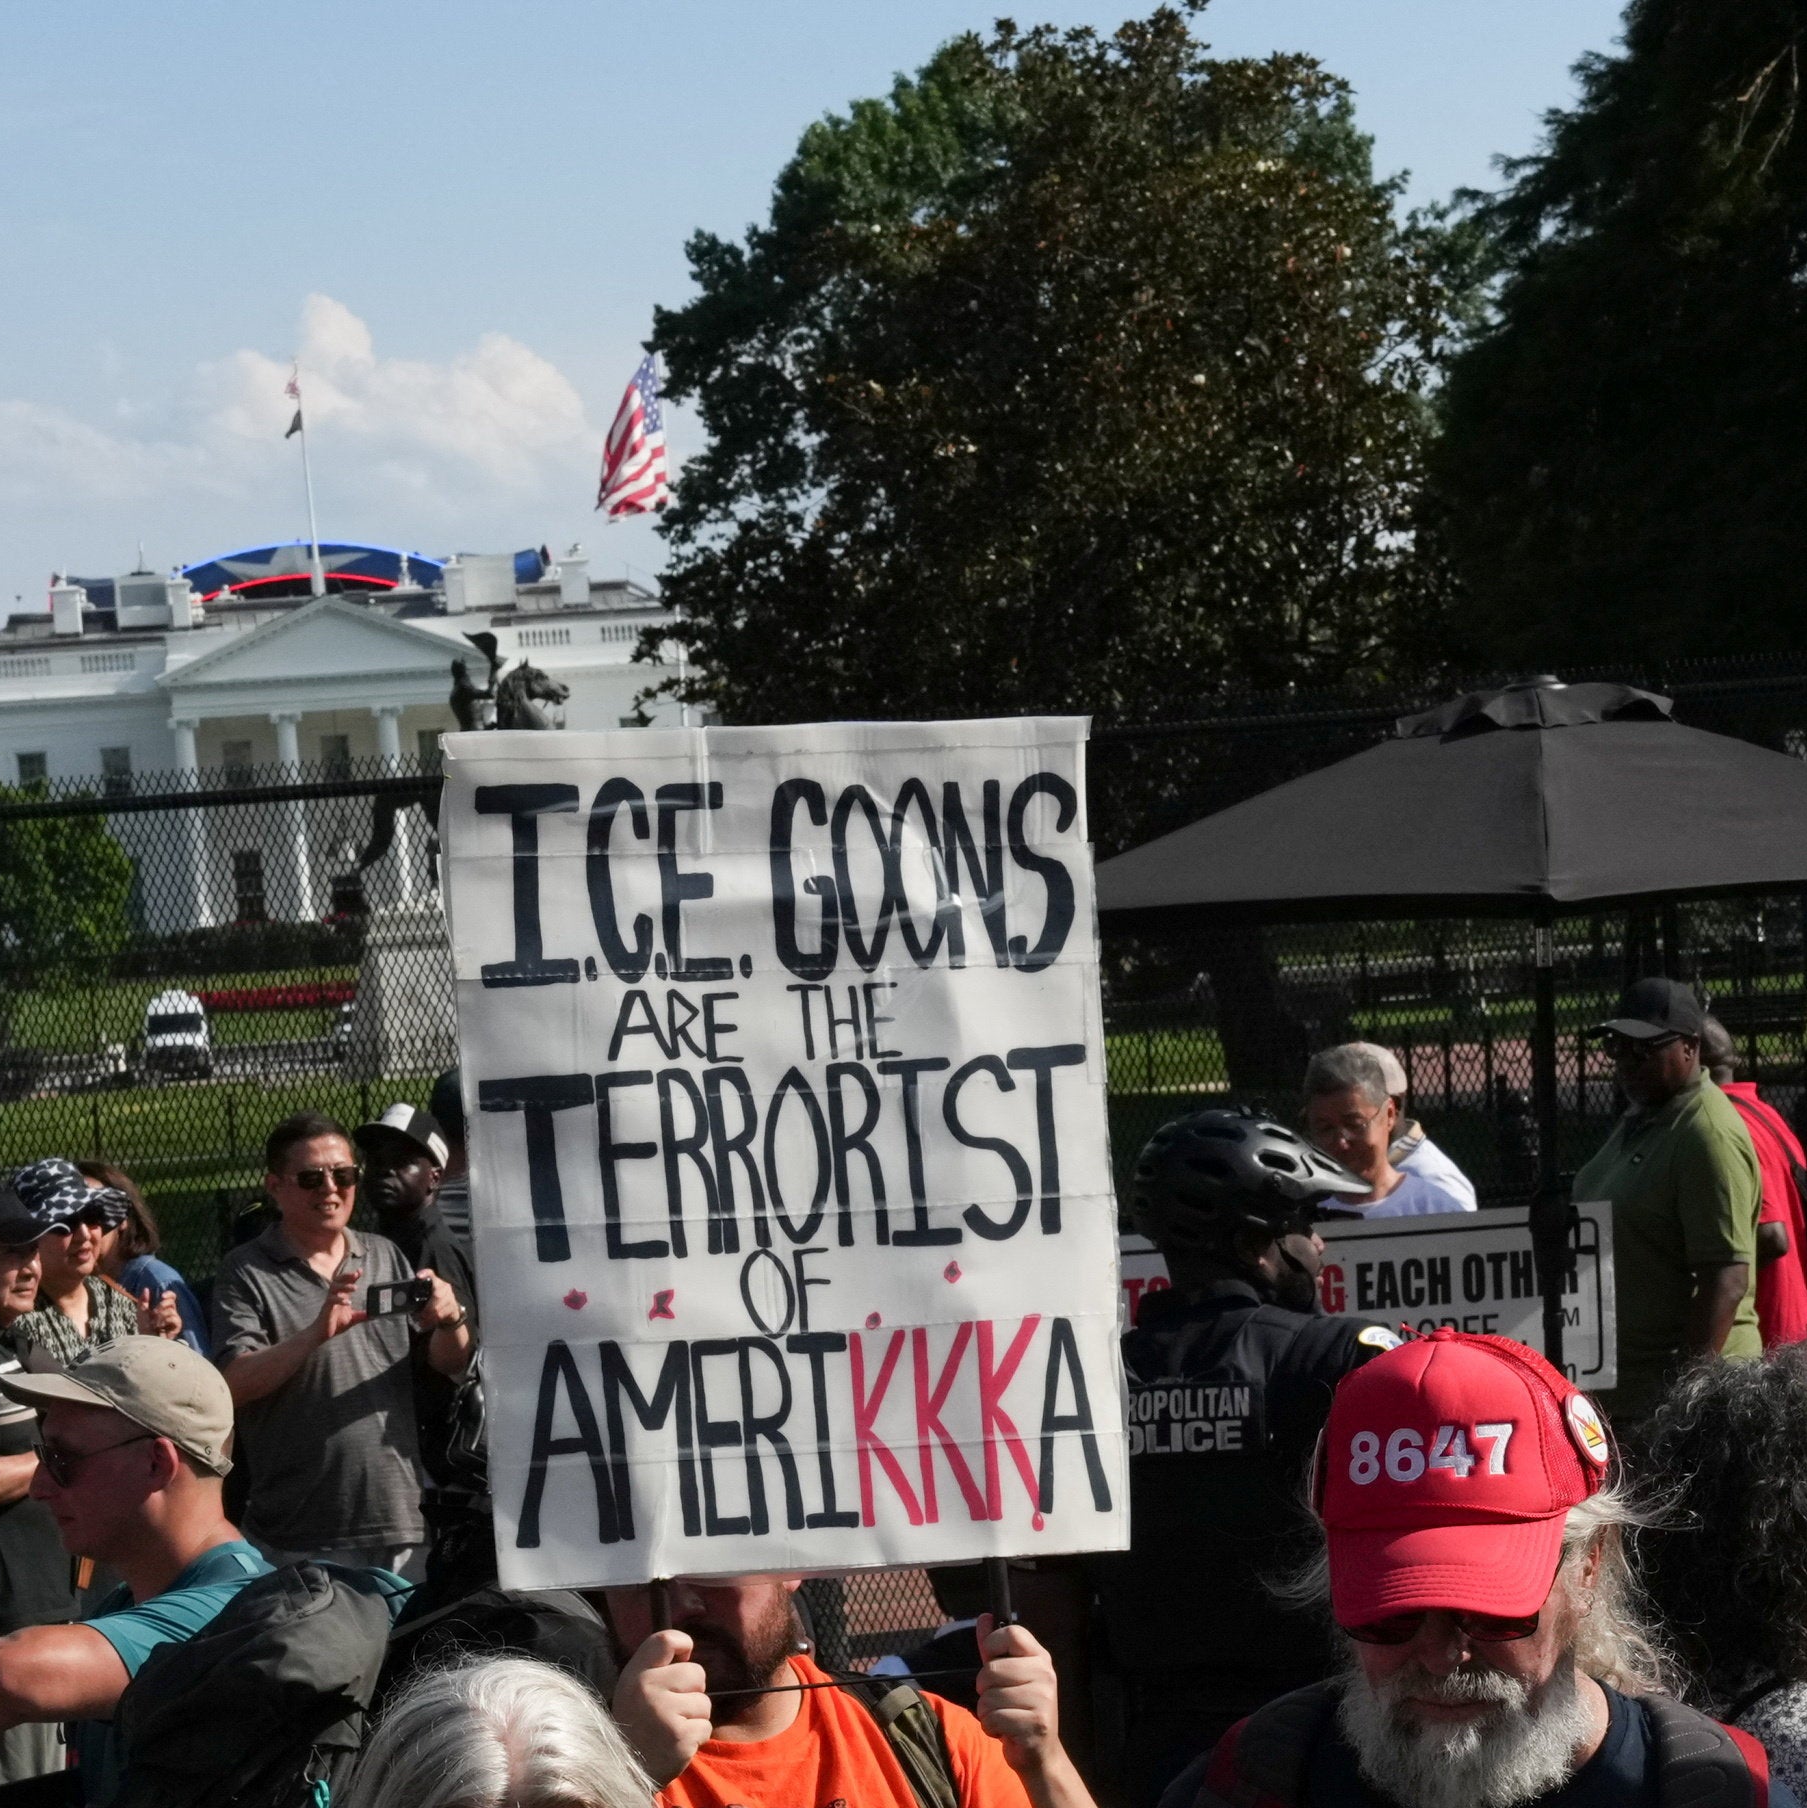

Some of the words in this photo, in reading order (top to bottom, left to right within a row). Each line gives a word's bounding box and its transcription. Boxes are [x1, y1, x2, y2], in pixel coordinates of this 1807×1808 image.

[769, 772, 1079, 980] GOONS
[608, 990, 741, 1063] ARE
[787, 982, 904, 1061] THE
[478, 1044, 1087, 1263] TERRORIST
[740, 1248, 832, 1338] OF
[1357, 1256, 1452, 1311] EACH
[516, 1313, 1113, 1549] AMERIKKKA
[1349, 1422, 1513, 1485] 8647
